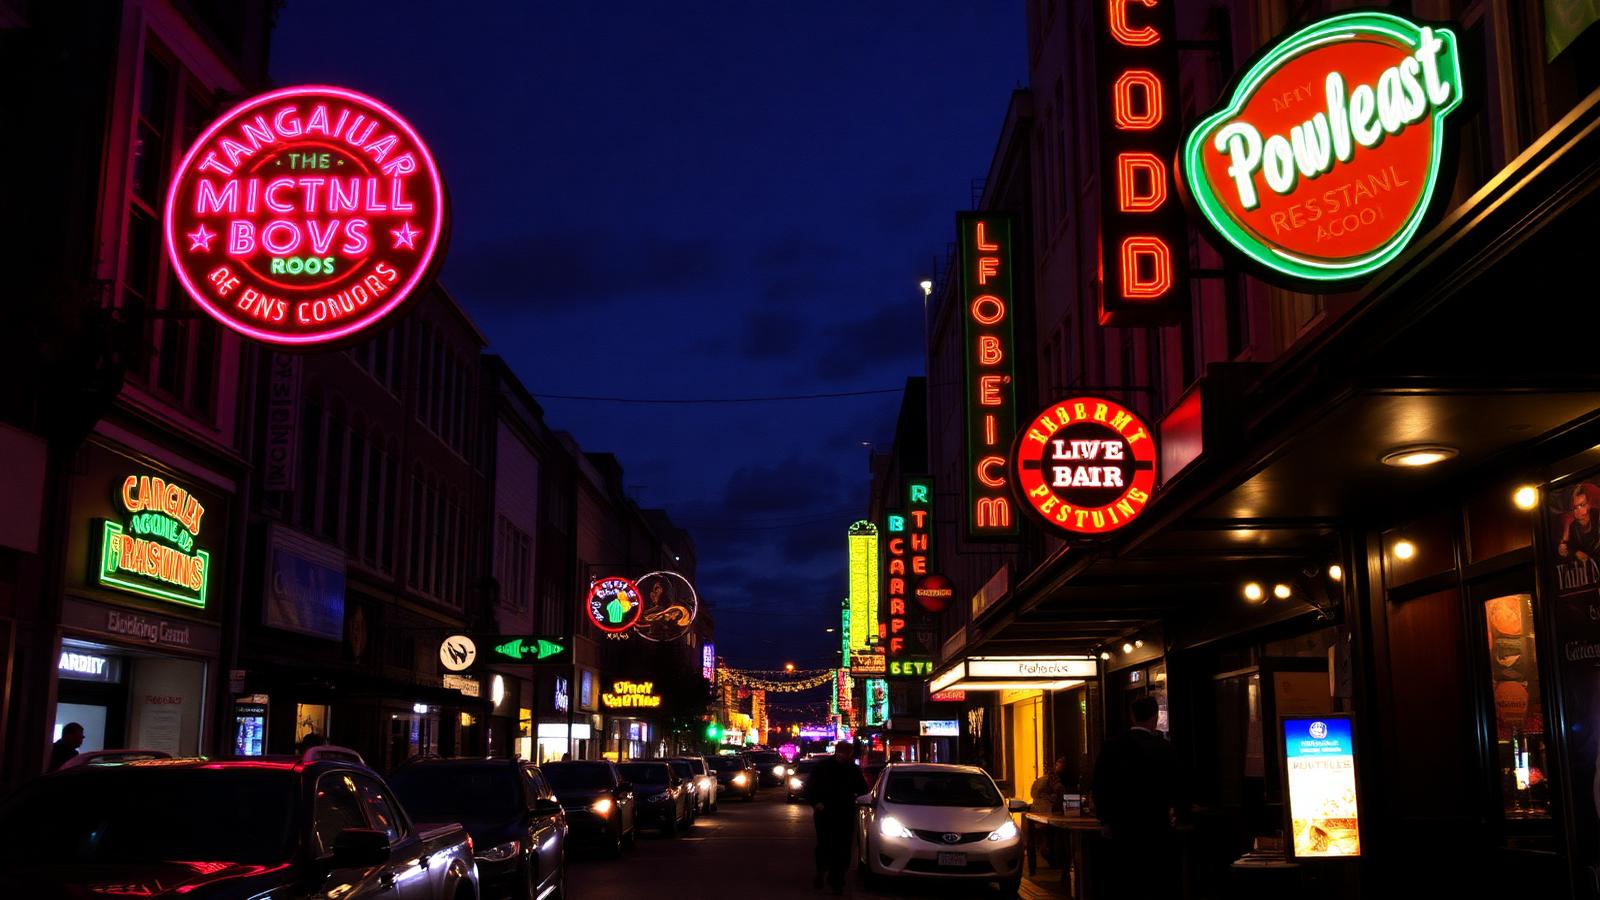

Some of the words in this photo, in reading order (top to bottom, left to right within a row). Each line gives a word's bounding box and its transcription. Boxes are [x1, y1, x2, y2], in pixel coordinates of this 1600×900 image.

[1214, 26, 1451, 209] Powleast
[288, 152, 331, 170] THE
[196, 176, 414, 214] MICTNLL
[229, 218, 371, 256] BOVS
[270, 256, 336, 276] ROOS
[1052, 439, 1124, 460] LIVE
[1052, 466, 1124, 487] BAIR
